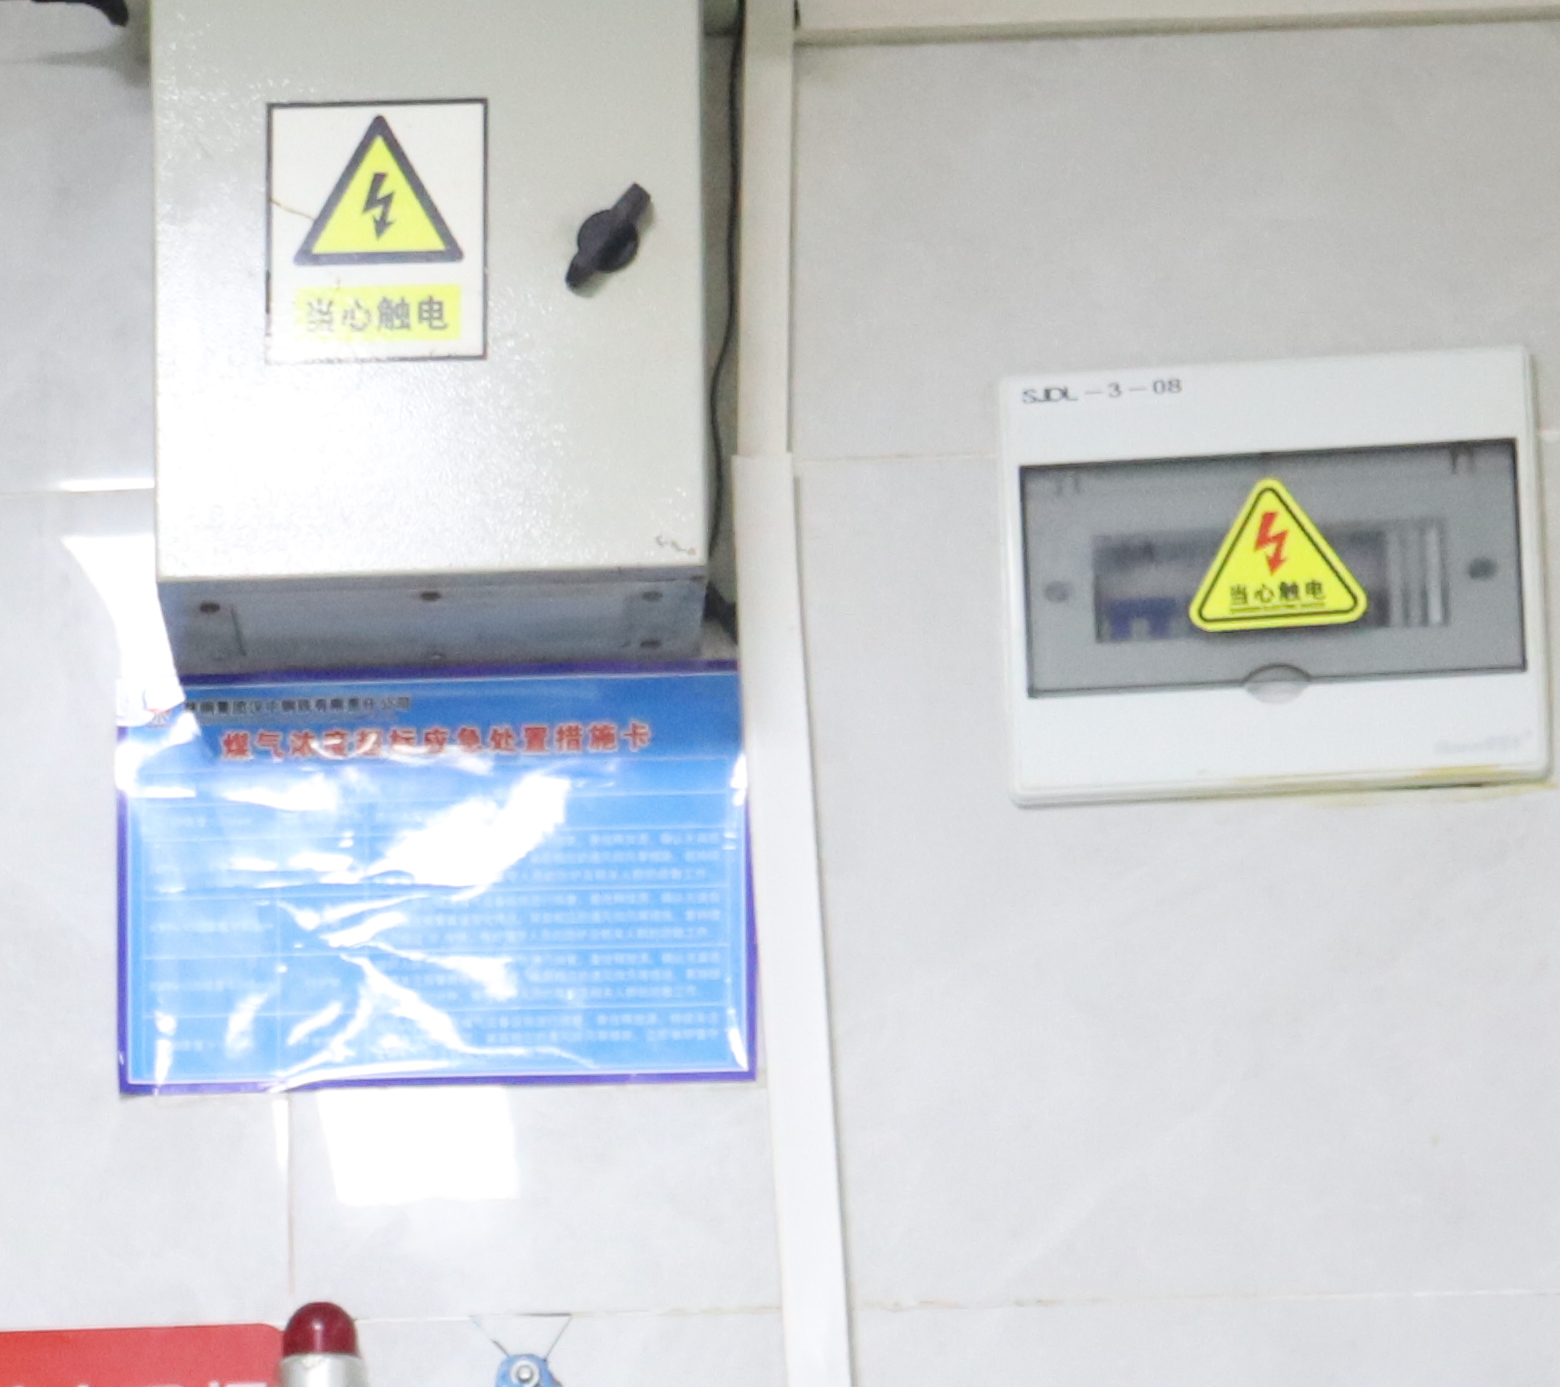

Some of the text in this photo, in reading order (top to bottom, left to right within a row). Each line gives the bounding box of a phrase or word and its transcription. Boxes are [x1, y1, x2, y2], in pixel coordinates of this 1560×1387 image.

[308, 296, 448, 333] 当心触电
[1230, 580, 1326, 605] 当心触电
